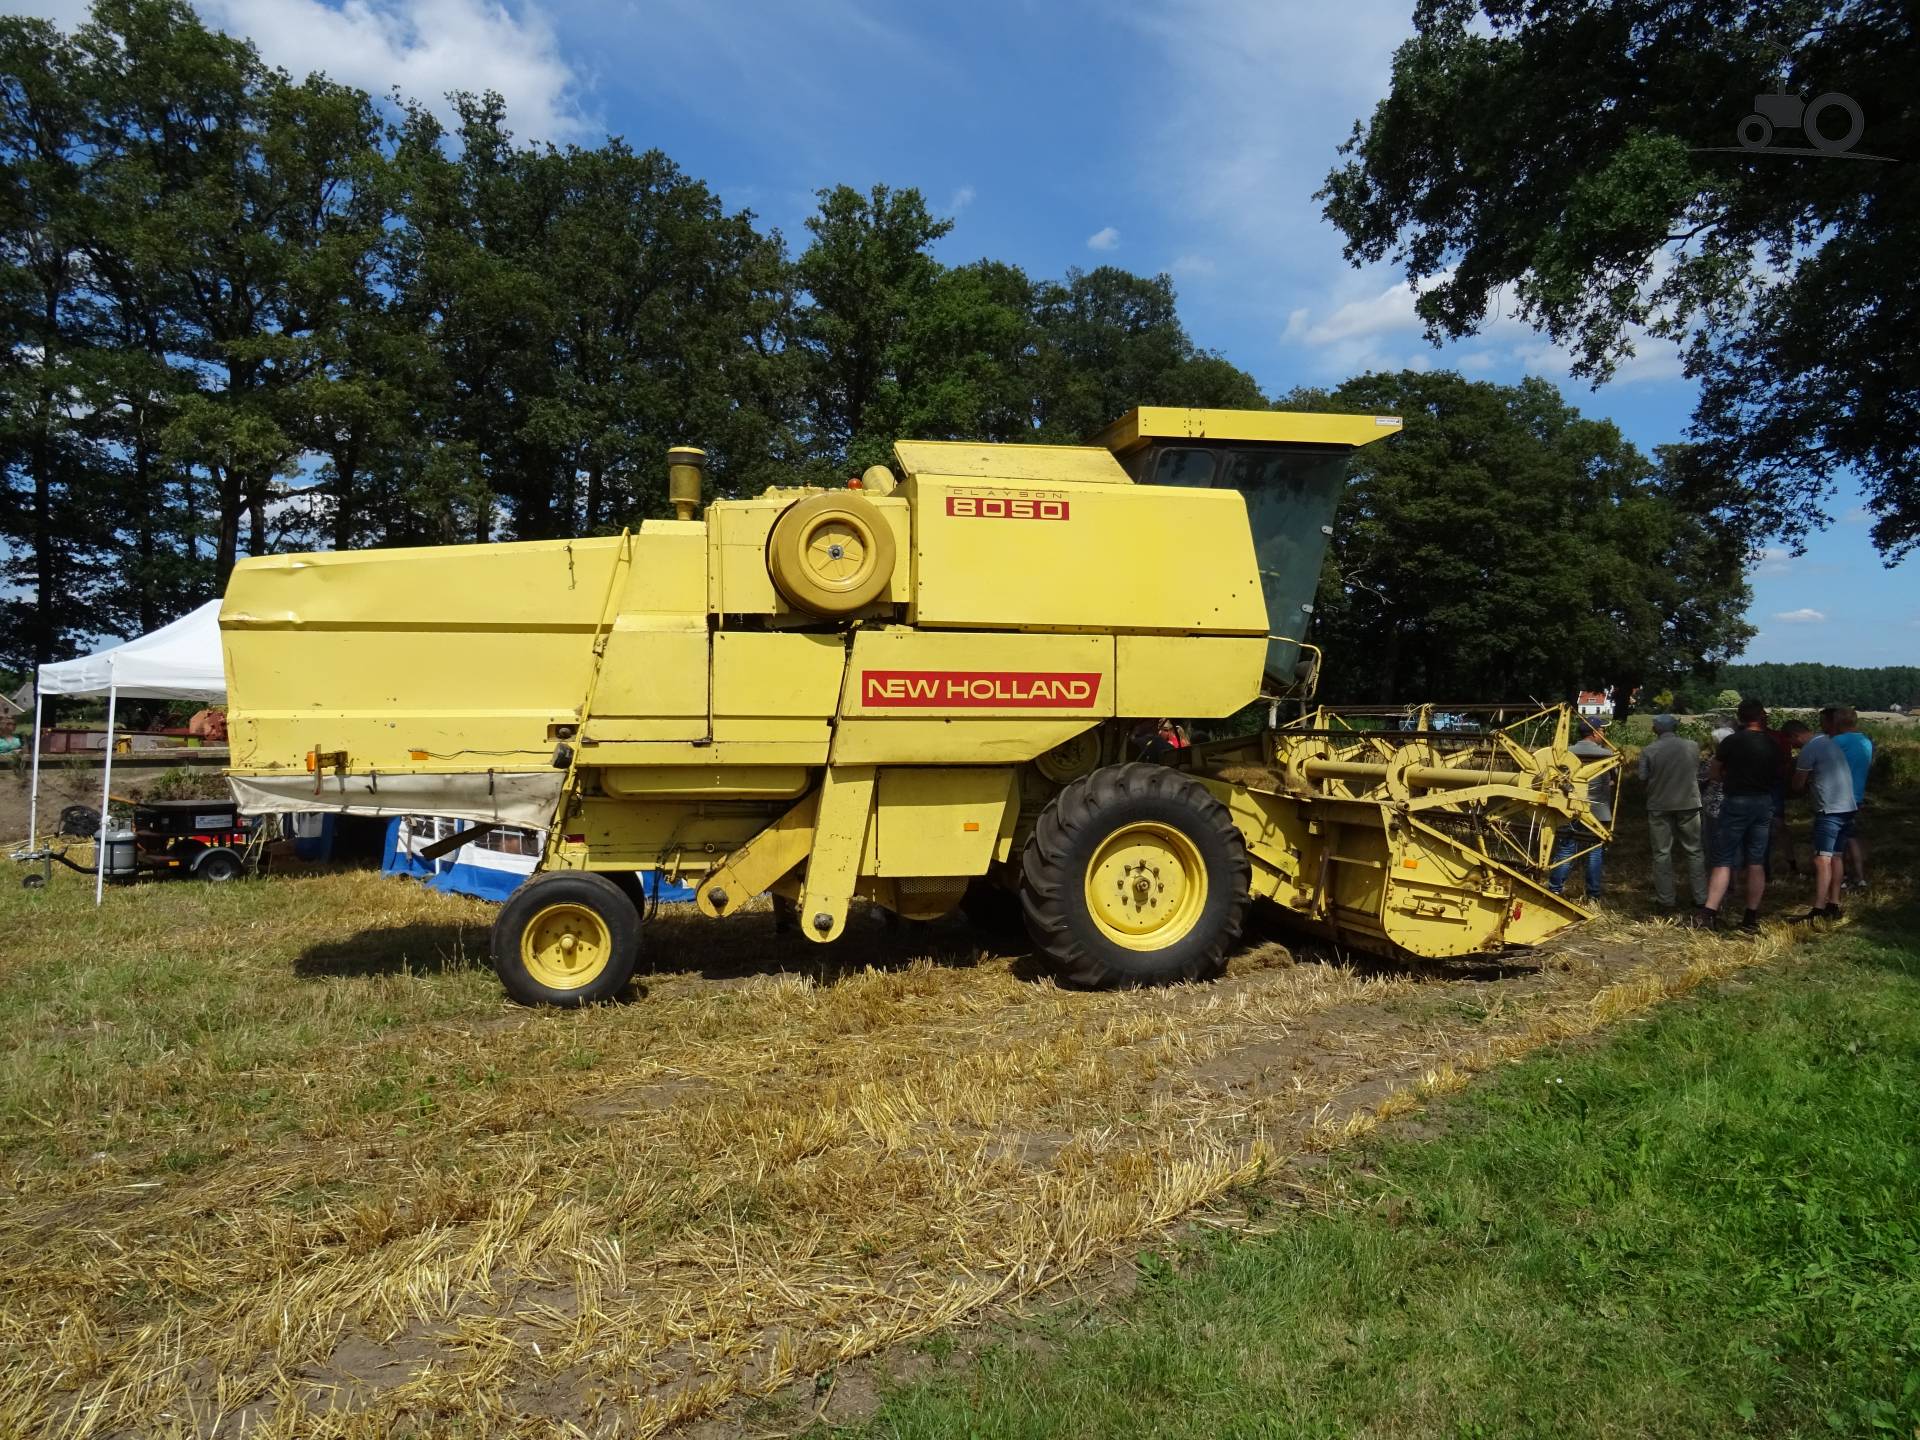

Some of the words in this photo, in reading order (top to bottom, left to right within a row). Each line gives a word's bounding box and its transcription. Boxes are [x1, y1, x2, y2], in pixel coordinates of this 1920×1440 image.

[953, 489, 1063, 499] CLAYSON
[953, 498, 1063, 519] 8050
[868, 679, 939, 699] NEW
[947, 679, 1091, 700] HOLLAND
